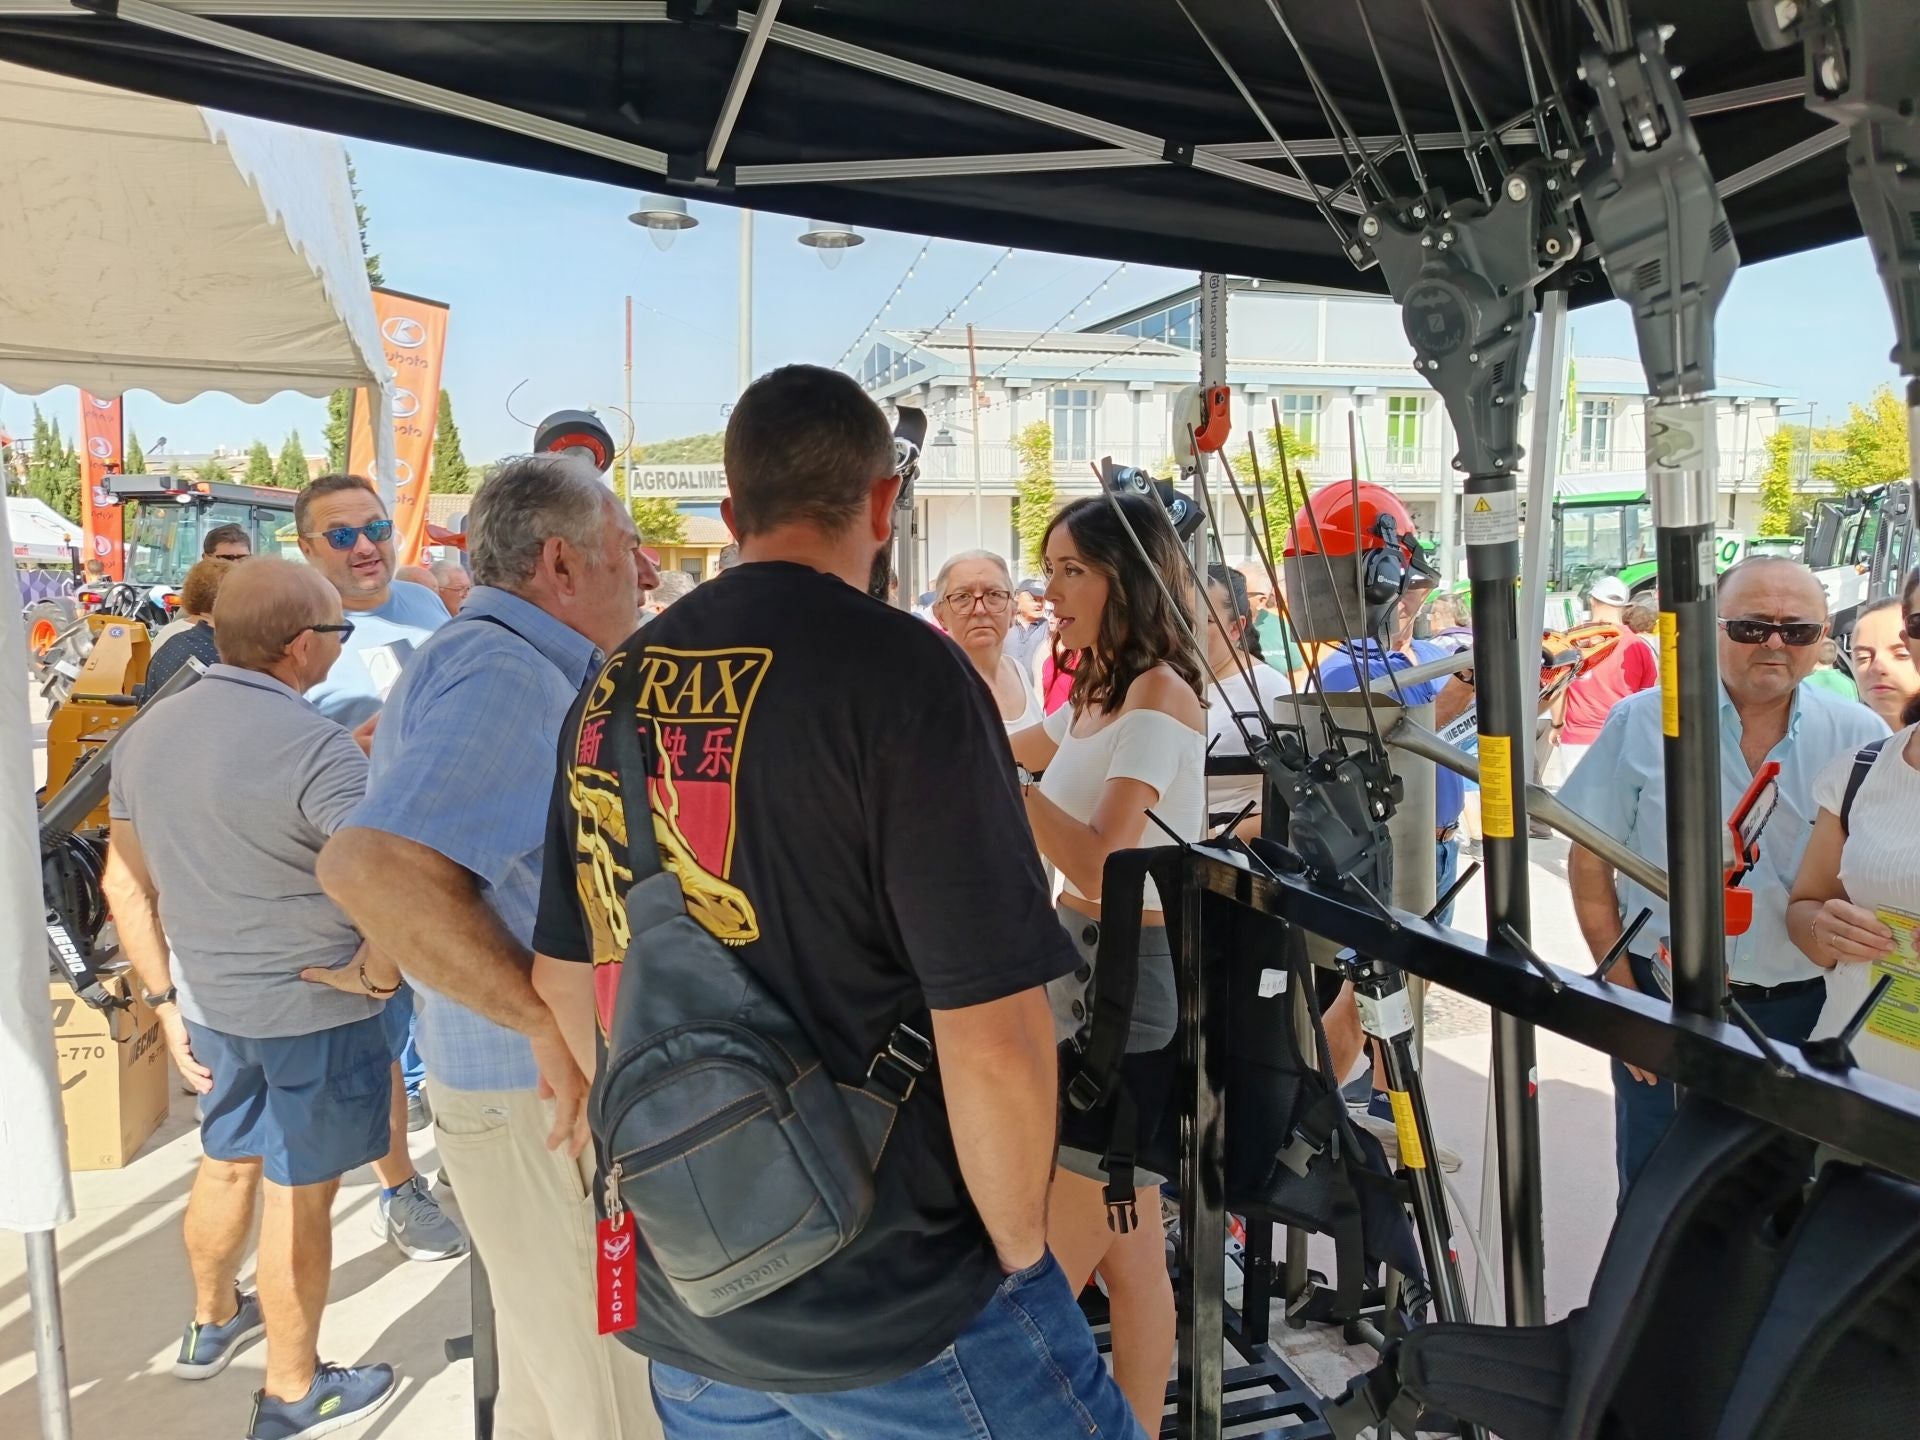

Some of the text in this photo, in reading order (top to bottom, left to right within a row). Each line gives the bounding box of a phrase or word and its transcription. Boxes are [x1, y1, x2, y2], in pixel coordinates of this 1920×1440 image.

[1209, 290, 1219, 358] Husqvarna
[384, 351, 429, 369] ubota
[588, 658, 760, 714] SRAX
[577, 719, 733, 777] 新快乐
[51, 932, 87, 973] ECHO
[611, 1267, 622, 1323] VALOR
